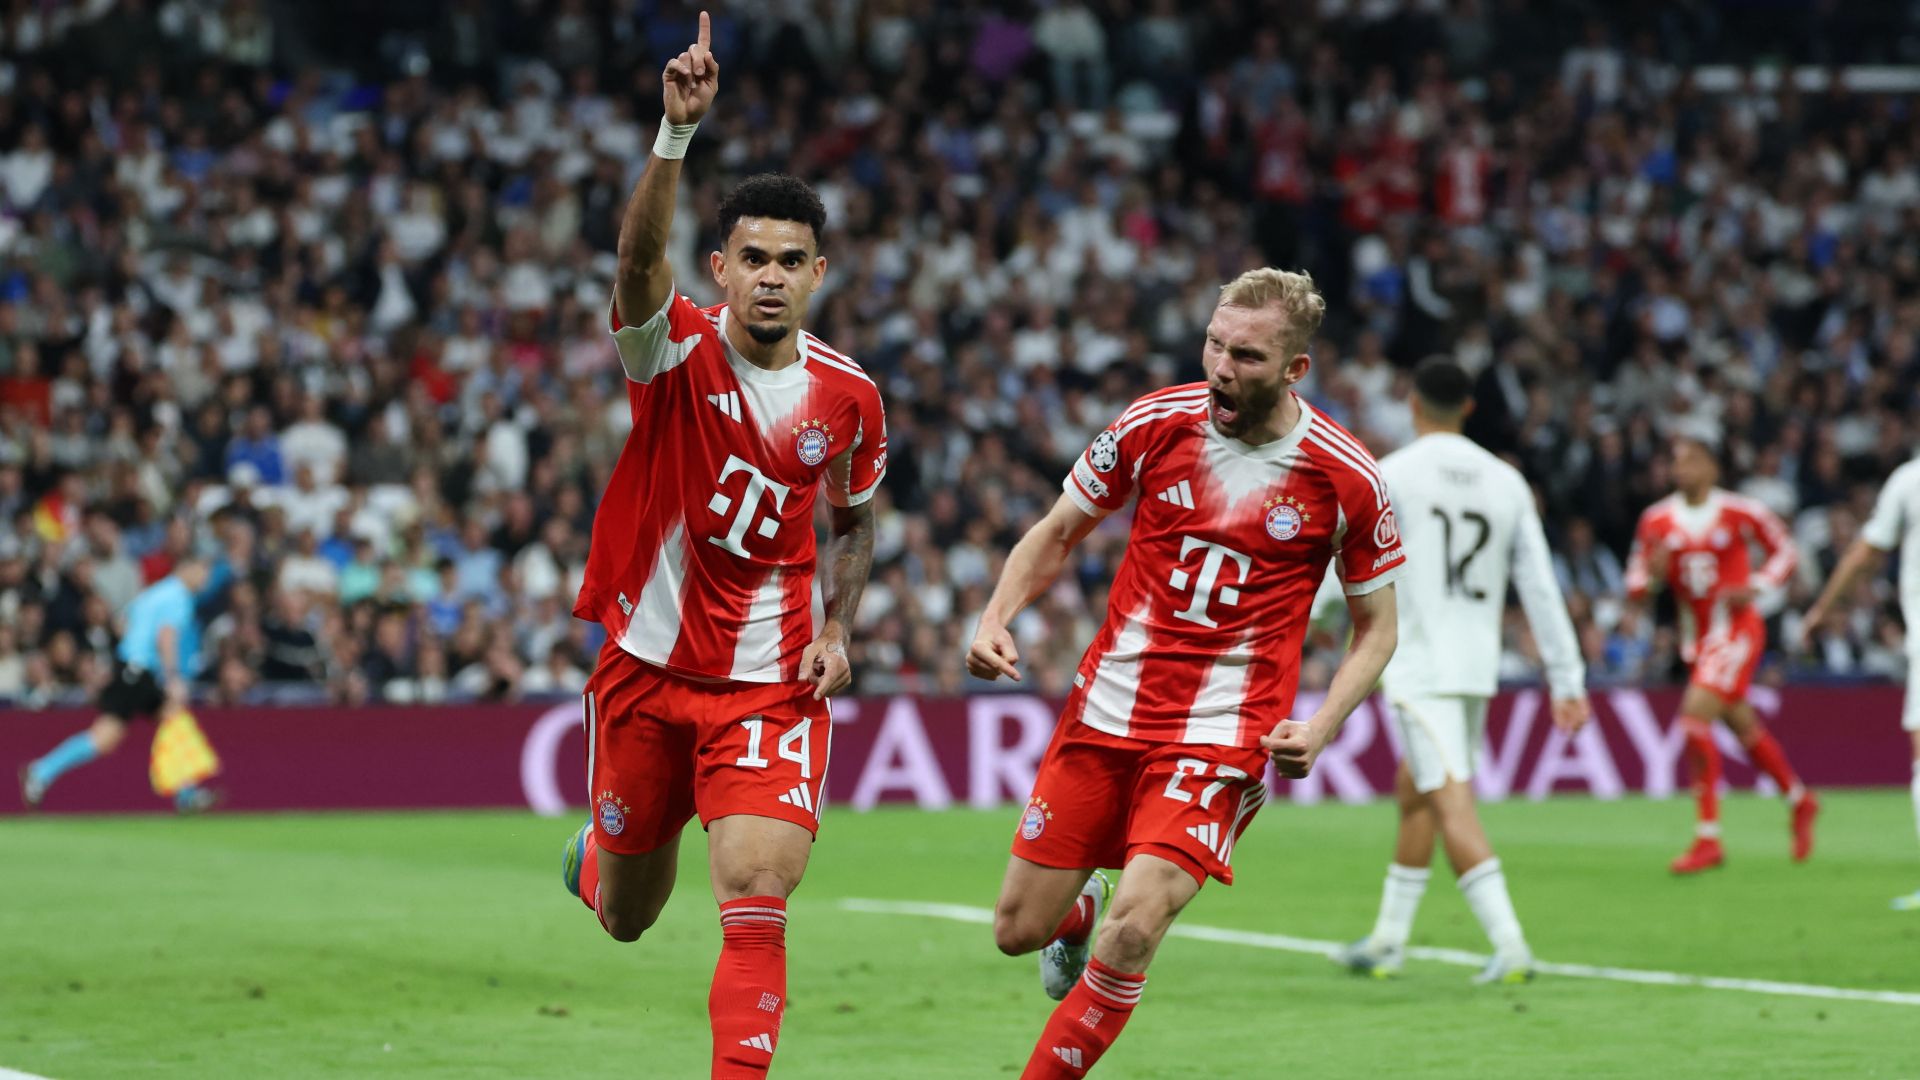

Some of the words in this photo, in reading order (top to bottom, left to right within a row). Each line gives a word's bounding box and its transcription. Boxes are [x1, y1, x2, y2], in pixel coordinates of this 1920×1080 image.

[807, 432, 826, 447] BAYERN
[707, 454, 790, 559] T
[1169, 535, 1252, 629] T
[1430, 506, 1491, 600] 12
[736, 714, 812, 779] 14
[1163, 758, 1248, 810] 27
